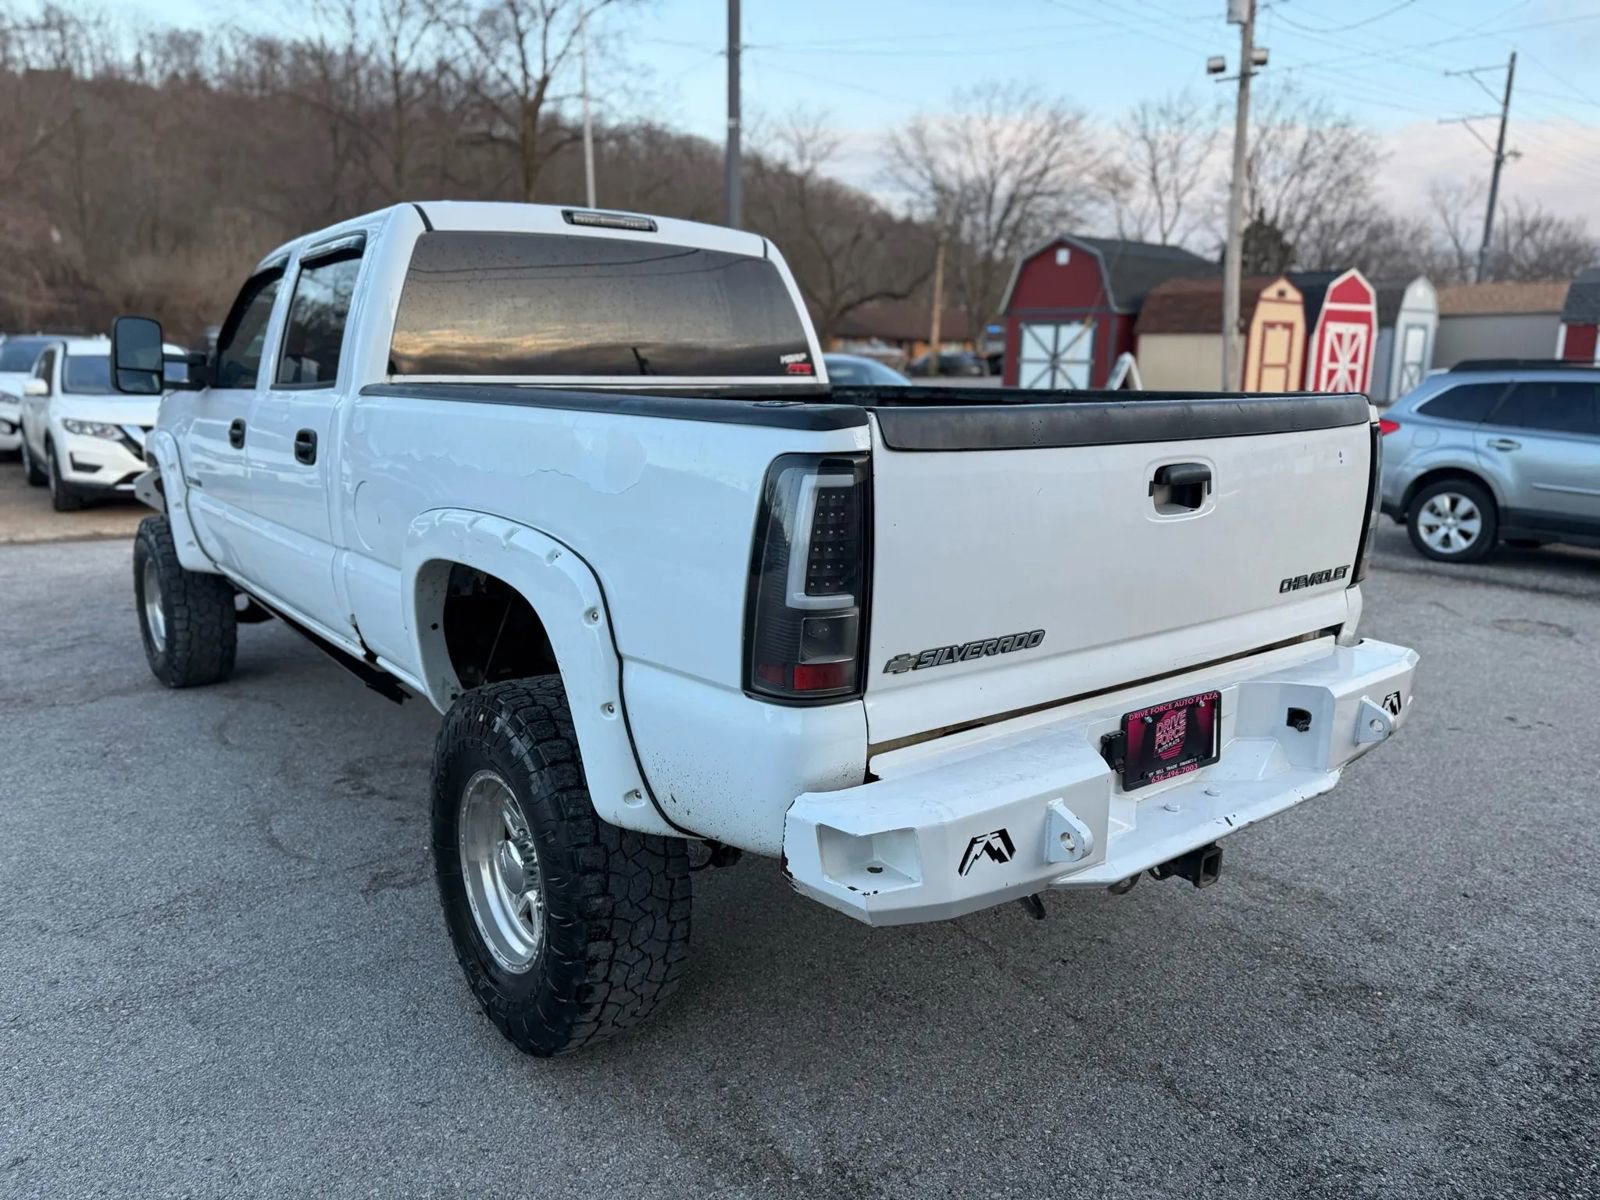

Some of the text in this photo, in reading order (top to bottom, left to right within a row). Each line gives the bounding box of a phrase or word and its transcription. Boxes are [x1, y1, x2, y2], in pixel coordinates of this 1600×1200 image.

[1279, 565, 1351, 594] CHEVROLET
[912, 629, 1045, 670] SILVERADO
[1128, 692, 1218, 721] DRIVE FORCE AUTO PLAZA
[1155, 721, 1187, 749] FORCE
[1156, 709, 1187, 736] DRIVE
